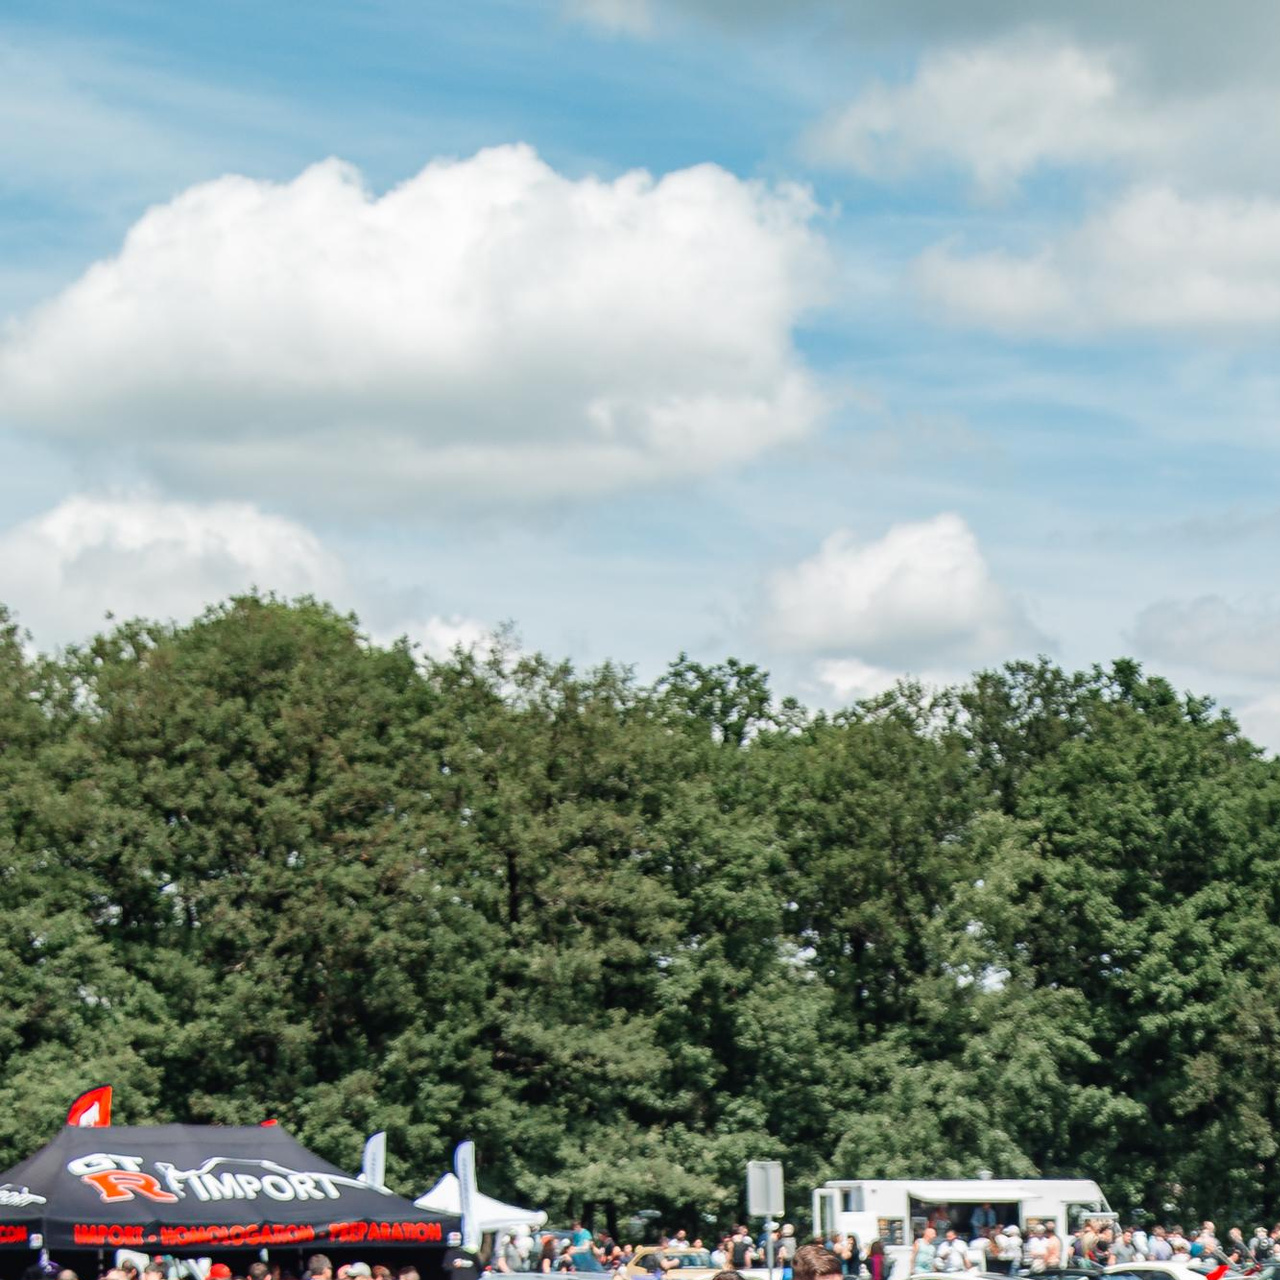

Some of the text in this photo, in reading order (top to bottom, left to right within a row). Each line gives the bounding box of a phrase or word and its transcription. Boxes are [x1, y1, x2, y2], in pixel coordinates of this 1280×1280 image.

[67, 1153, 143, 1175] GT
[81, 1169, 179, 1203] R
[188, 1172, 341, 1201] IMPORT
[74, 1223, 144, 1245] IMPORT
[160, 1222, 315, 1246] HOMOLOGATION
[328, 1221, 442, 1242] PREPARATION
